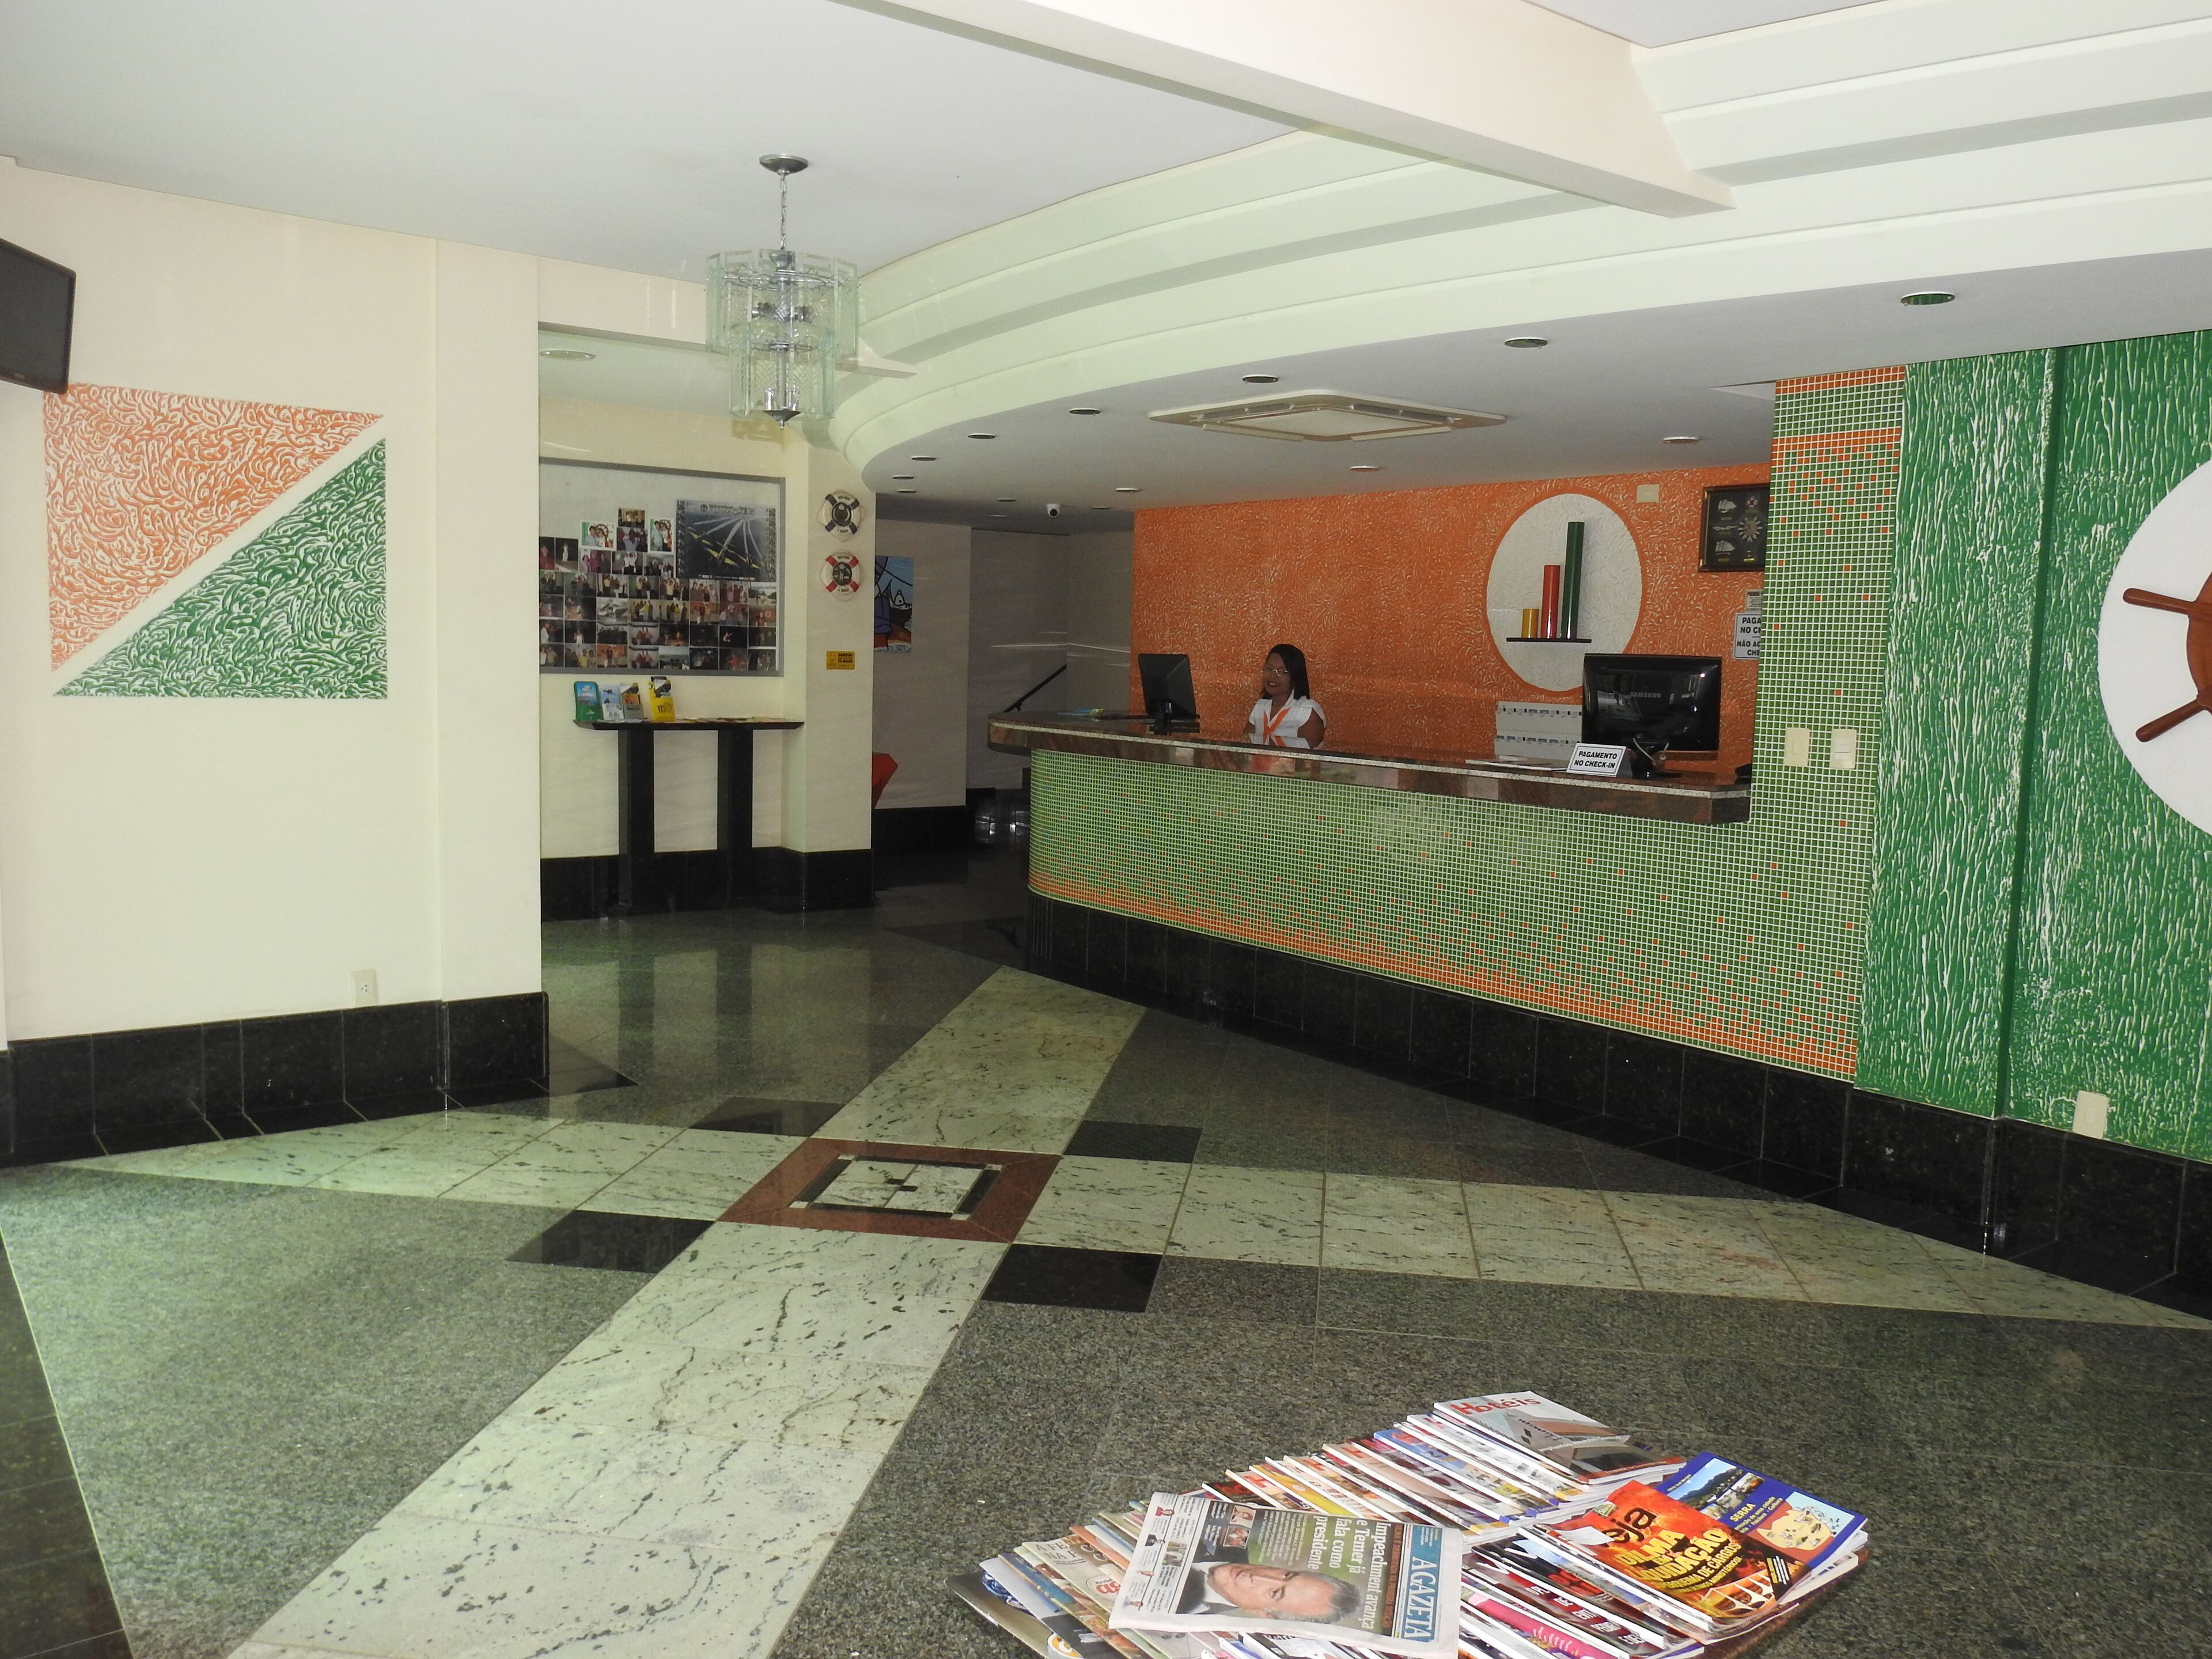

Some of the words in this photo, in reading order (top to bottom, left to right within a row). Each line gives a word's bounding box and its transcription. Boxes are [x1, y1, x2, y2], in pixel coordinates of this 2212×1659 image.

[1737, 639, 1751, 647] NÃO
[1578, 751, 1618, 759] PAGAMENTO
[1585, 760, 1616, 768] CHECK-IN
[1449, 1397, 1541, 1415] Hotéis
[1729, 1503, 1756, 1522] SERRA
[1334, 1518, 1352, 1537] fala
[1601, 1507, 1657, 1544] eja
[1308, 1515, 1328, 1570] presidente
[1350, 1529, 1370, 1564] Temer
[1613, 1529, 1685, 1566] DILMA
[1044, 1551, 1066, 1559] NA
[1329, 1539, 1344, 1569] como
[1367, 1521, 1391, 1593] Impeachment
[1652, 1554, 1673, 1565] EM
[1697, 1565, 1715, 1579] DE
[1707, 1543, 1742, 1571] CARGOS
[1346, 1564, 1366, 1574] já
[1358, 1593, 1378, 1630] avança
